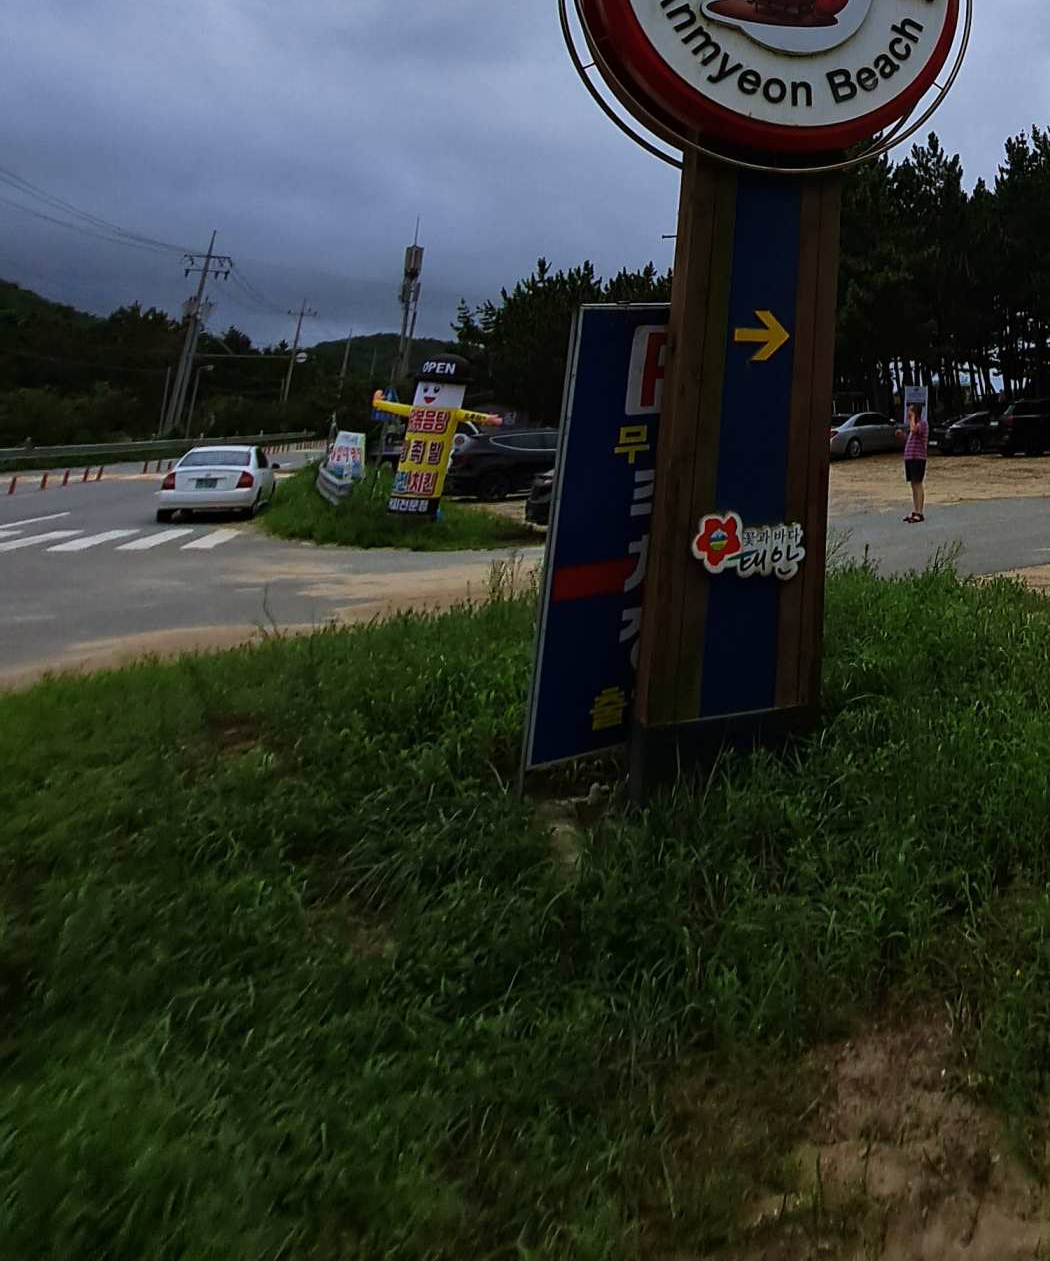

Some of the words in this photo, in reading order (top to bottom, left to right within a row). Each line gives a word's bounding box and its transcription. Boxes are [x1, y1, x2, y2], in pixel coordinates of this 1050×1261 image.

[826, 17, 924, 104] Beach
[423, 361, 456, 375] OPEN
[409, 410, 449, 433] 볶음탕
[730, 543, 800, 575] 태안
